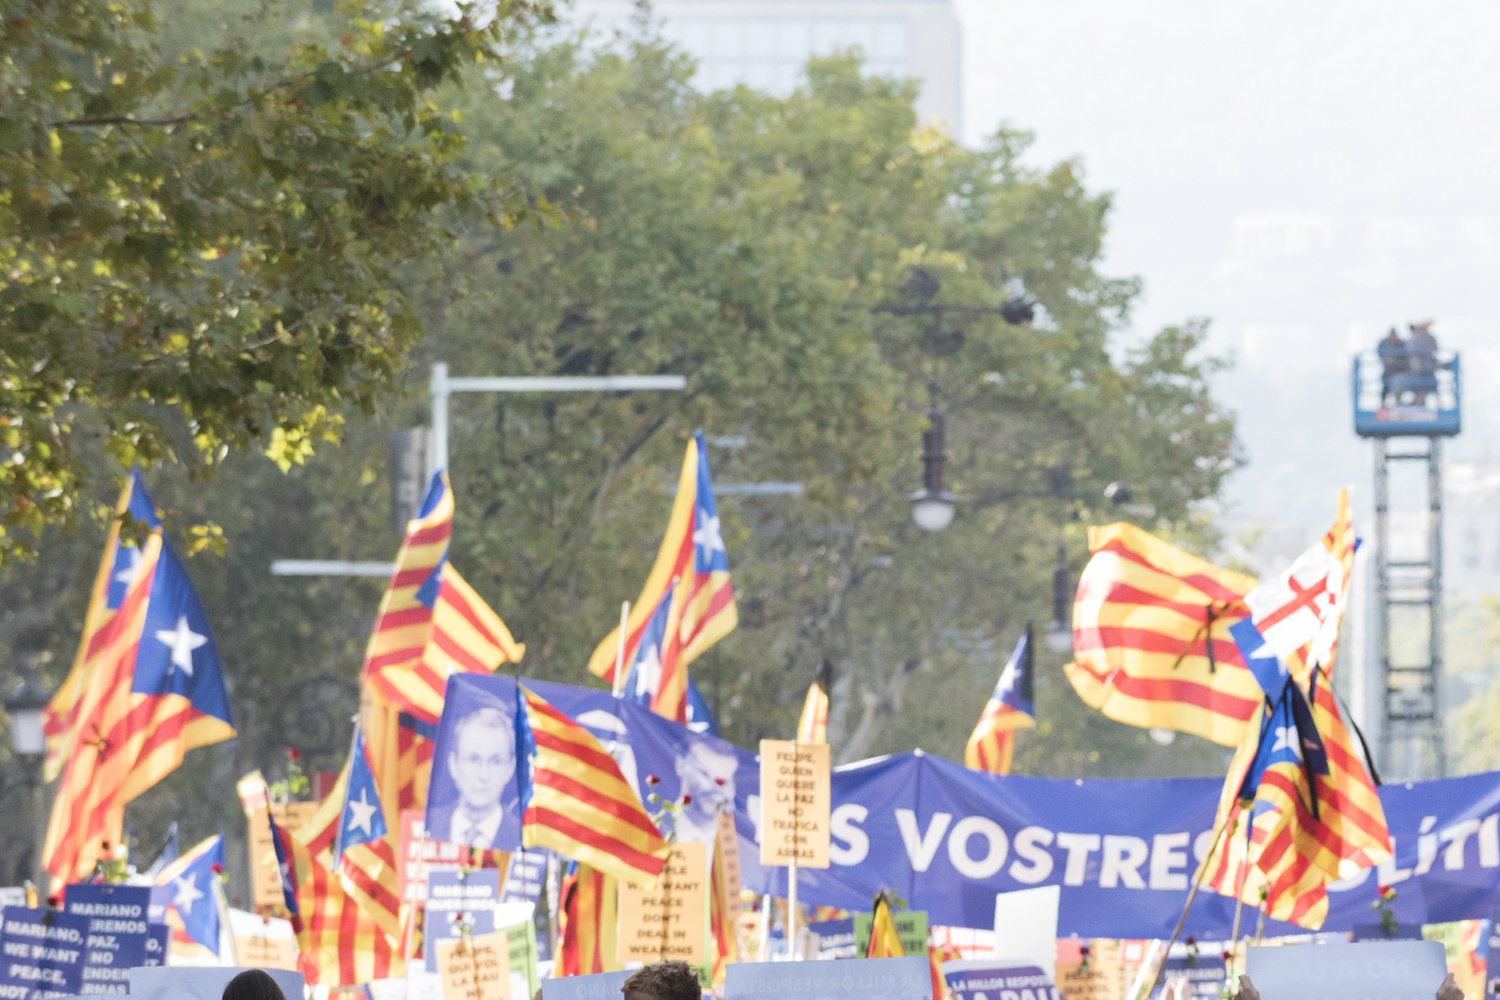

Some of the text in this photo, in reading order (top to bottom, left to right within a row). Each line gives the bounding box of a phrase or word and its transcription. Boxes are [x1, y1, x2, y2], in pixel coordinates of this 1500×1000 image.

[71, 902, 142, 918] MARIANO
[642, 898, 683, 907] PEACE
[6, 920, 84, 945] MARIANO,
[89, 918, 147, 934] REMOS
[86, 935, 120, 951] PAZ,
[629, 945, 693, 955] WEAPONS
[4, 942, 79, 964] WE WANT
[90, 951, 114, 965] NO
[10, 963, 67, 986] PEACE,
[953, 980, 965, 991] LA
[967, 977, 1005, 991] MILLOR
